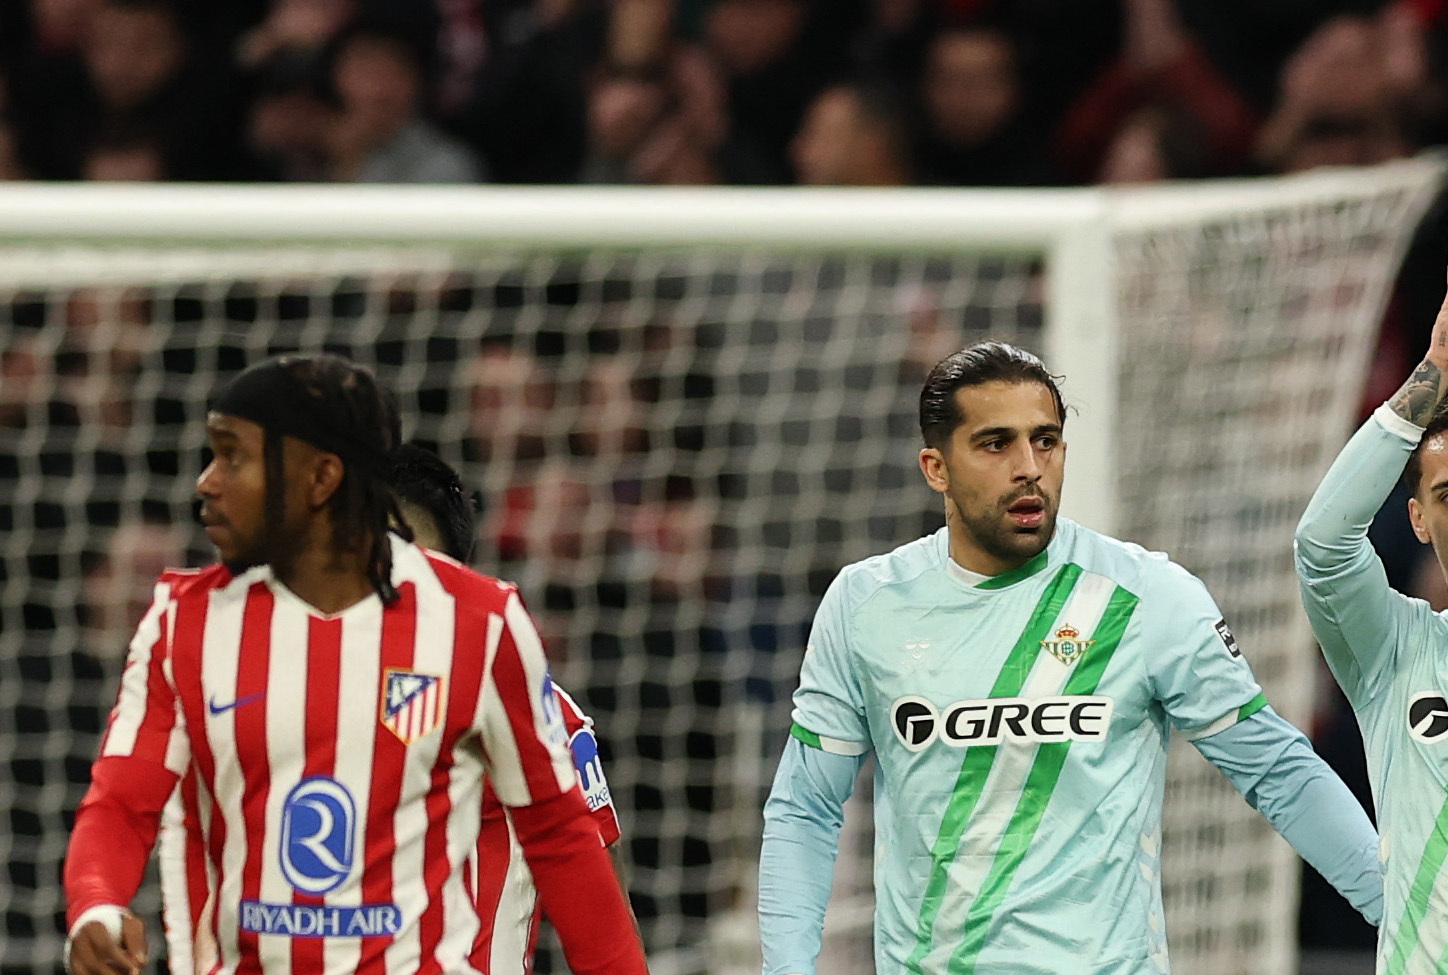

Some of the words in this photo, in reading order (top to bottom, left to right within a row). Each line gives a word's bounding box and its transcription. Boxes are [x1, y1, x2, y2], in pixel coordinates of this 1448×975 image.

[945, 702, 1107, 740] GREE
[242, 901, 340, 936] RIYADH
[346, 906, 400, 936] AIR
